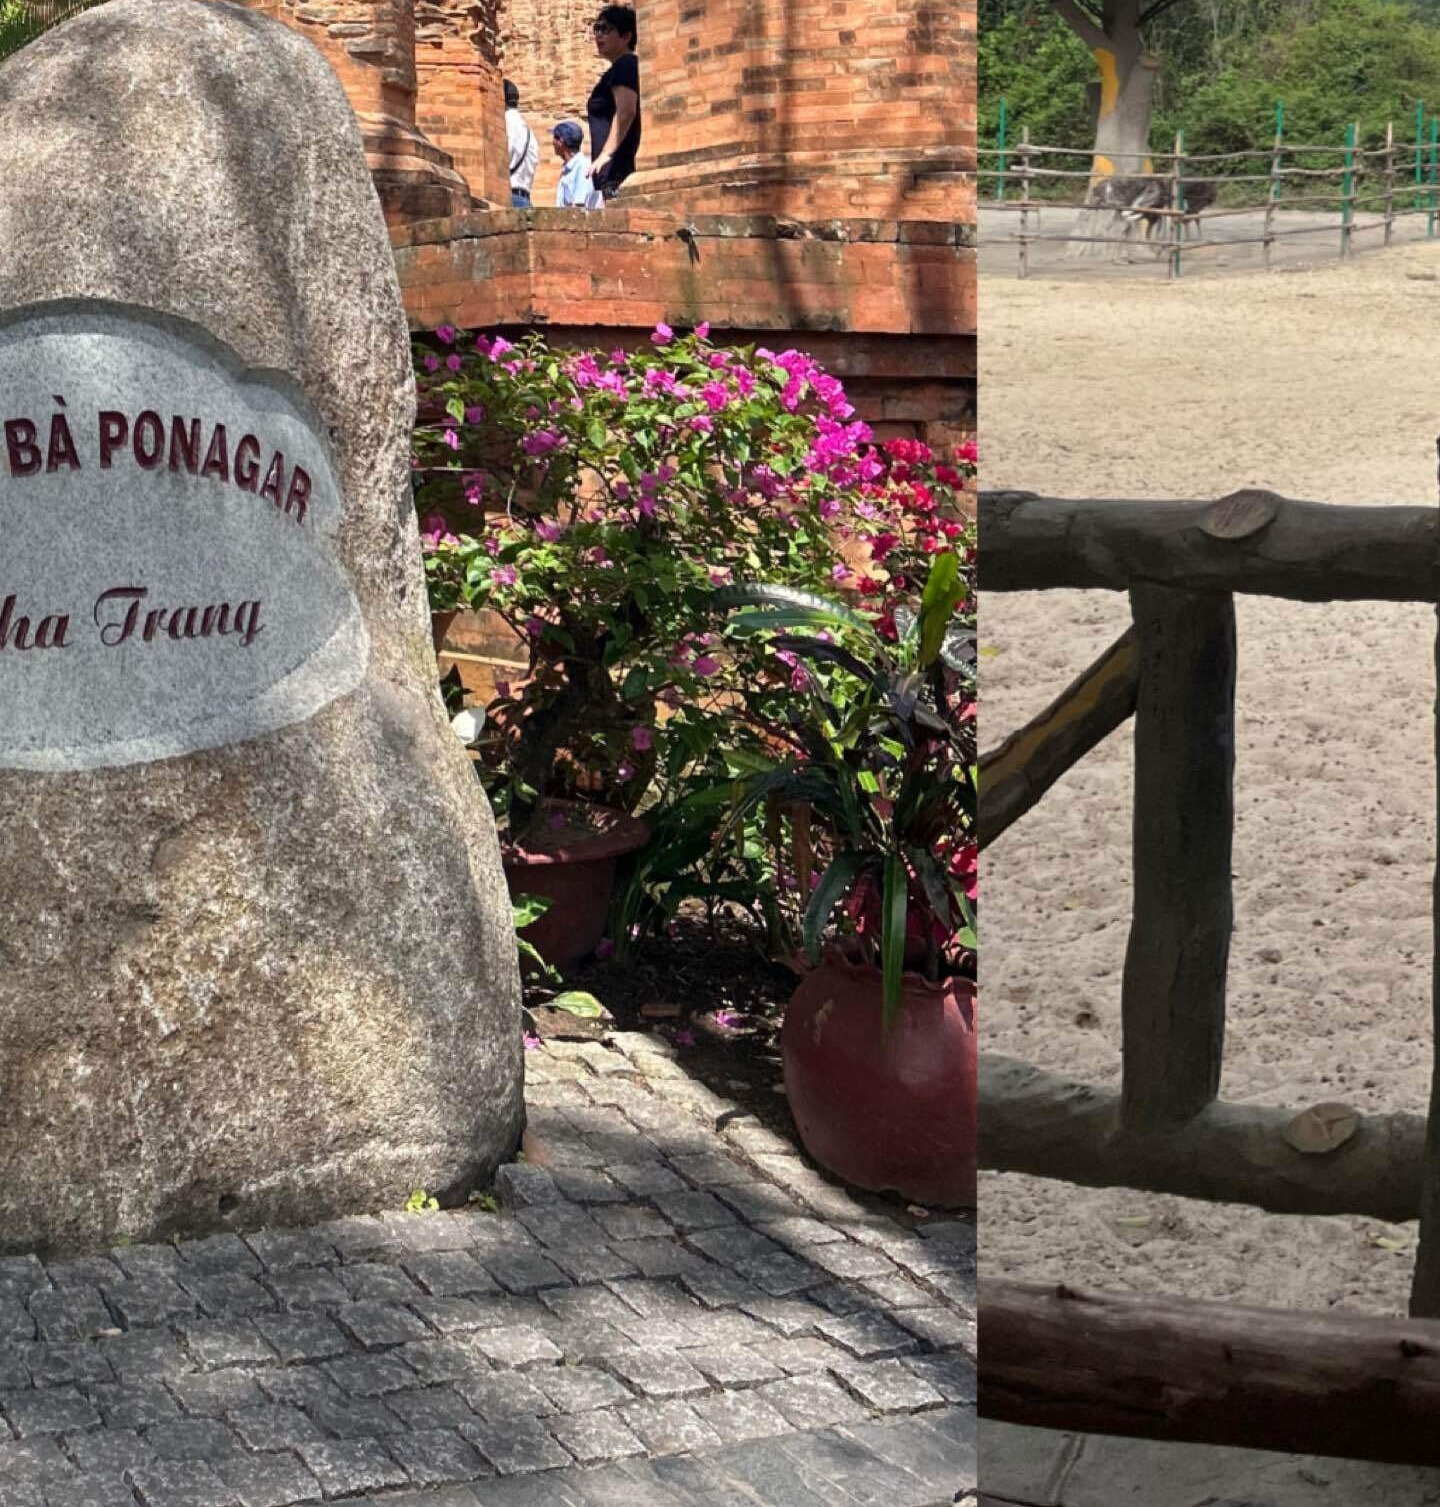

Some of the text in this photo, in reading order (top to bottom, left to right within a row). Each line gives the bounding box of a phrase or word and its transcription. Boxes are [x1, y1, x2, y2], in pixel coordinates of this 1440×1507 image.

[4, 395, 81, 478] BÀ
[99, 411, 312, 524] PONAGAR
[94, 587, 265, 647] Trang
